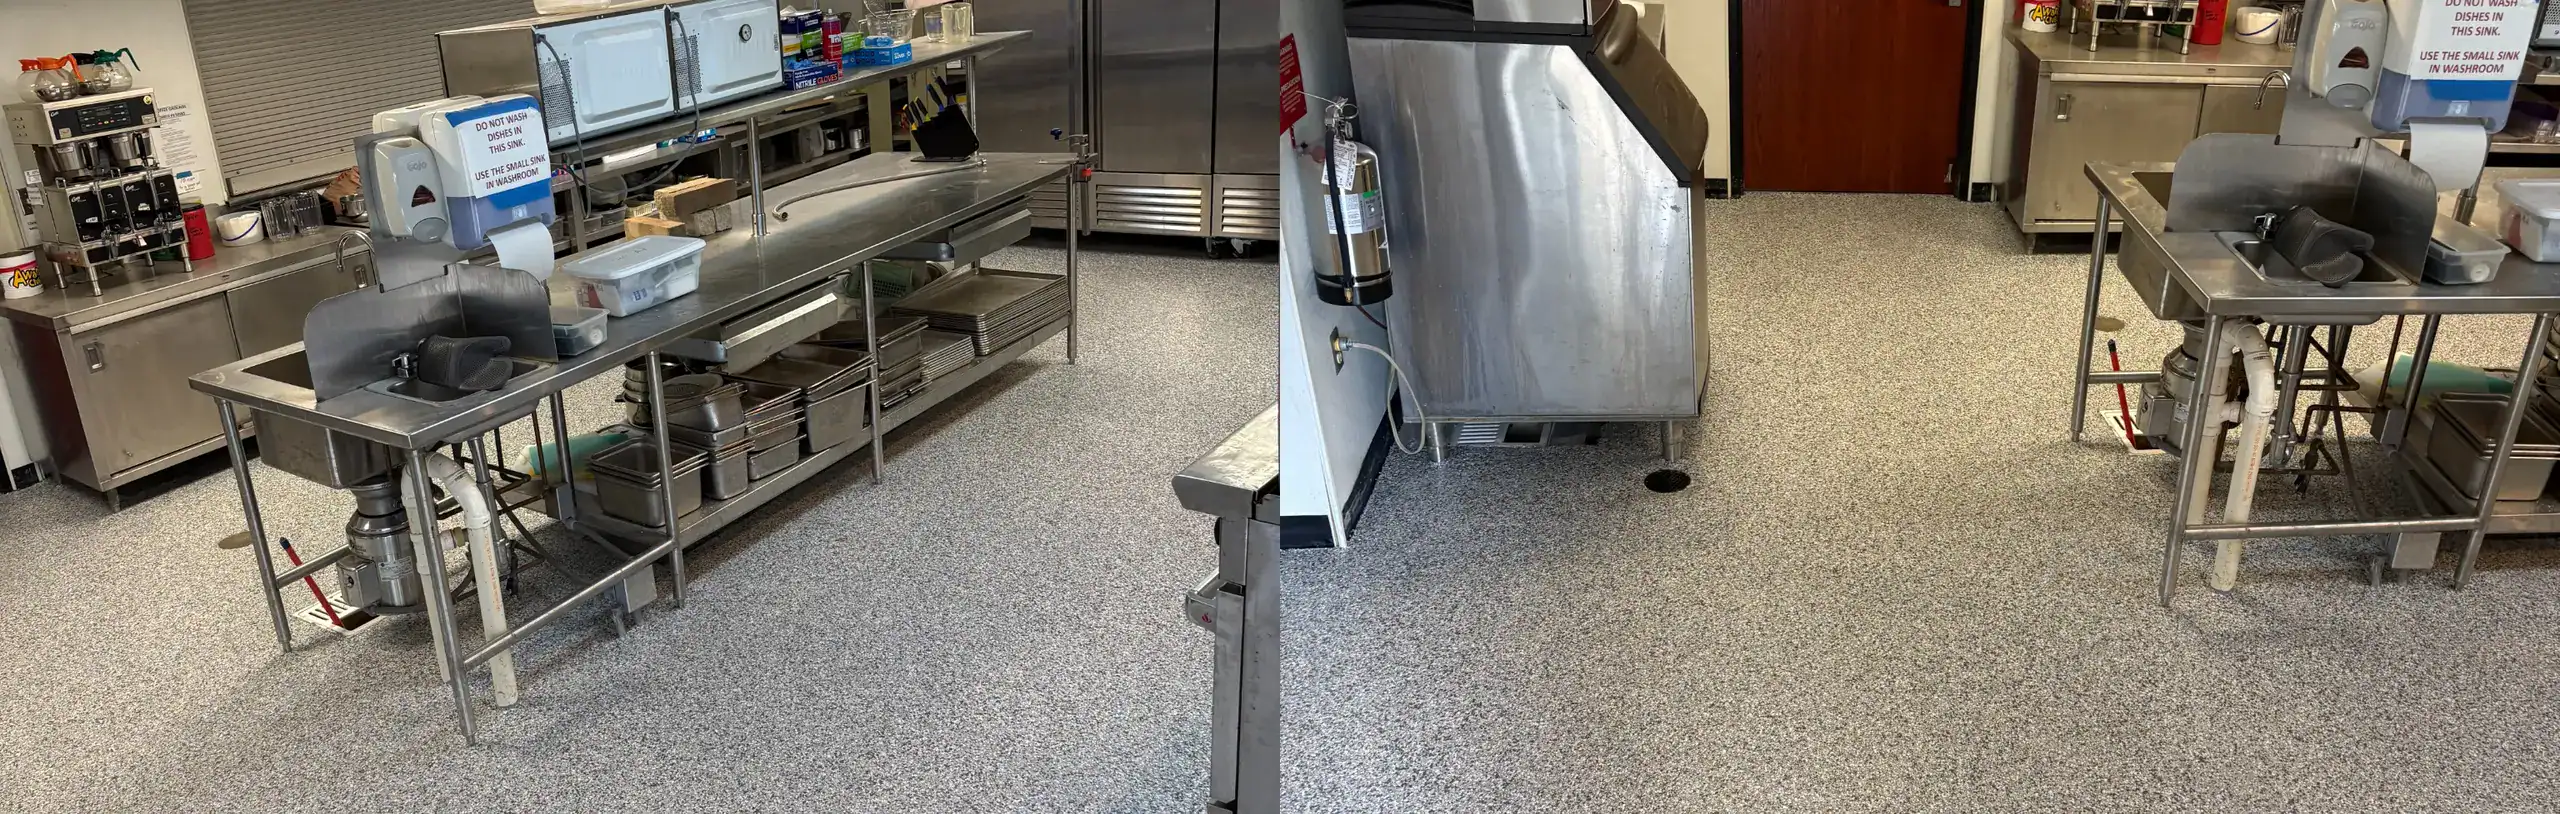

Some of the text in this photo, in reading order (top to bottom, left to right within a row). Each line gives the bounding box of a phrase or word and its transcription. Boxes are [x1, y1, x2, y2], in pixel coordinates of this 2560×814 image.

[2454, 11, 2504, 22] DISHES IN
[2451, 26, 2501, 36] THIS SINK.
[2420, 51, 2520, 61] USE THE SMALL SINK
[2428, 64, 2504, 74] IN WASHROOM
[795, 78, 817, 90] NITRILE
[816, 73, 838, 86] GLOVES
[475, 112, 528, 132] DO NOT WASH
[487, 126, 523, 142] DISHES IN
[488, 139, 526, 154] THIS SINK.
[475, 154, 546, 181] USE THE SMALL SINK
[486, 167, 539, 190] IN WASHROOM
